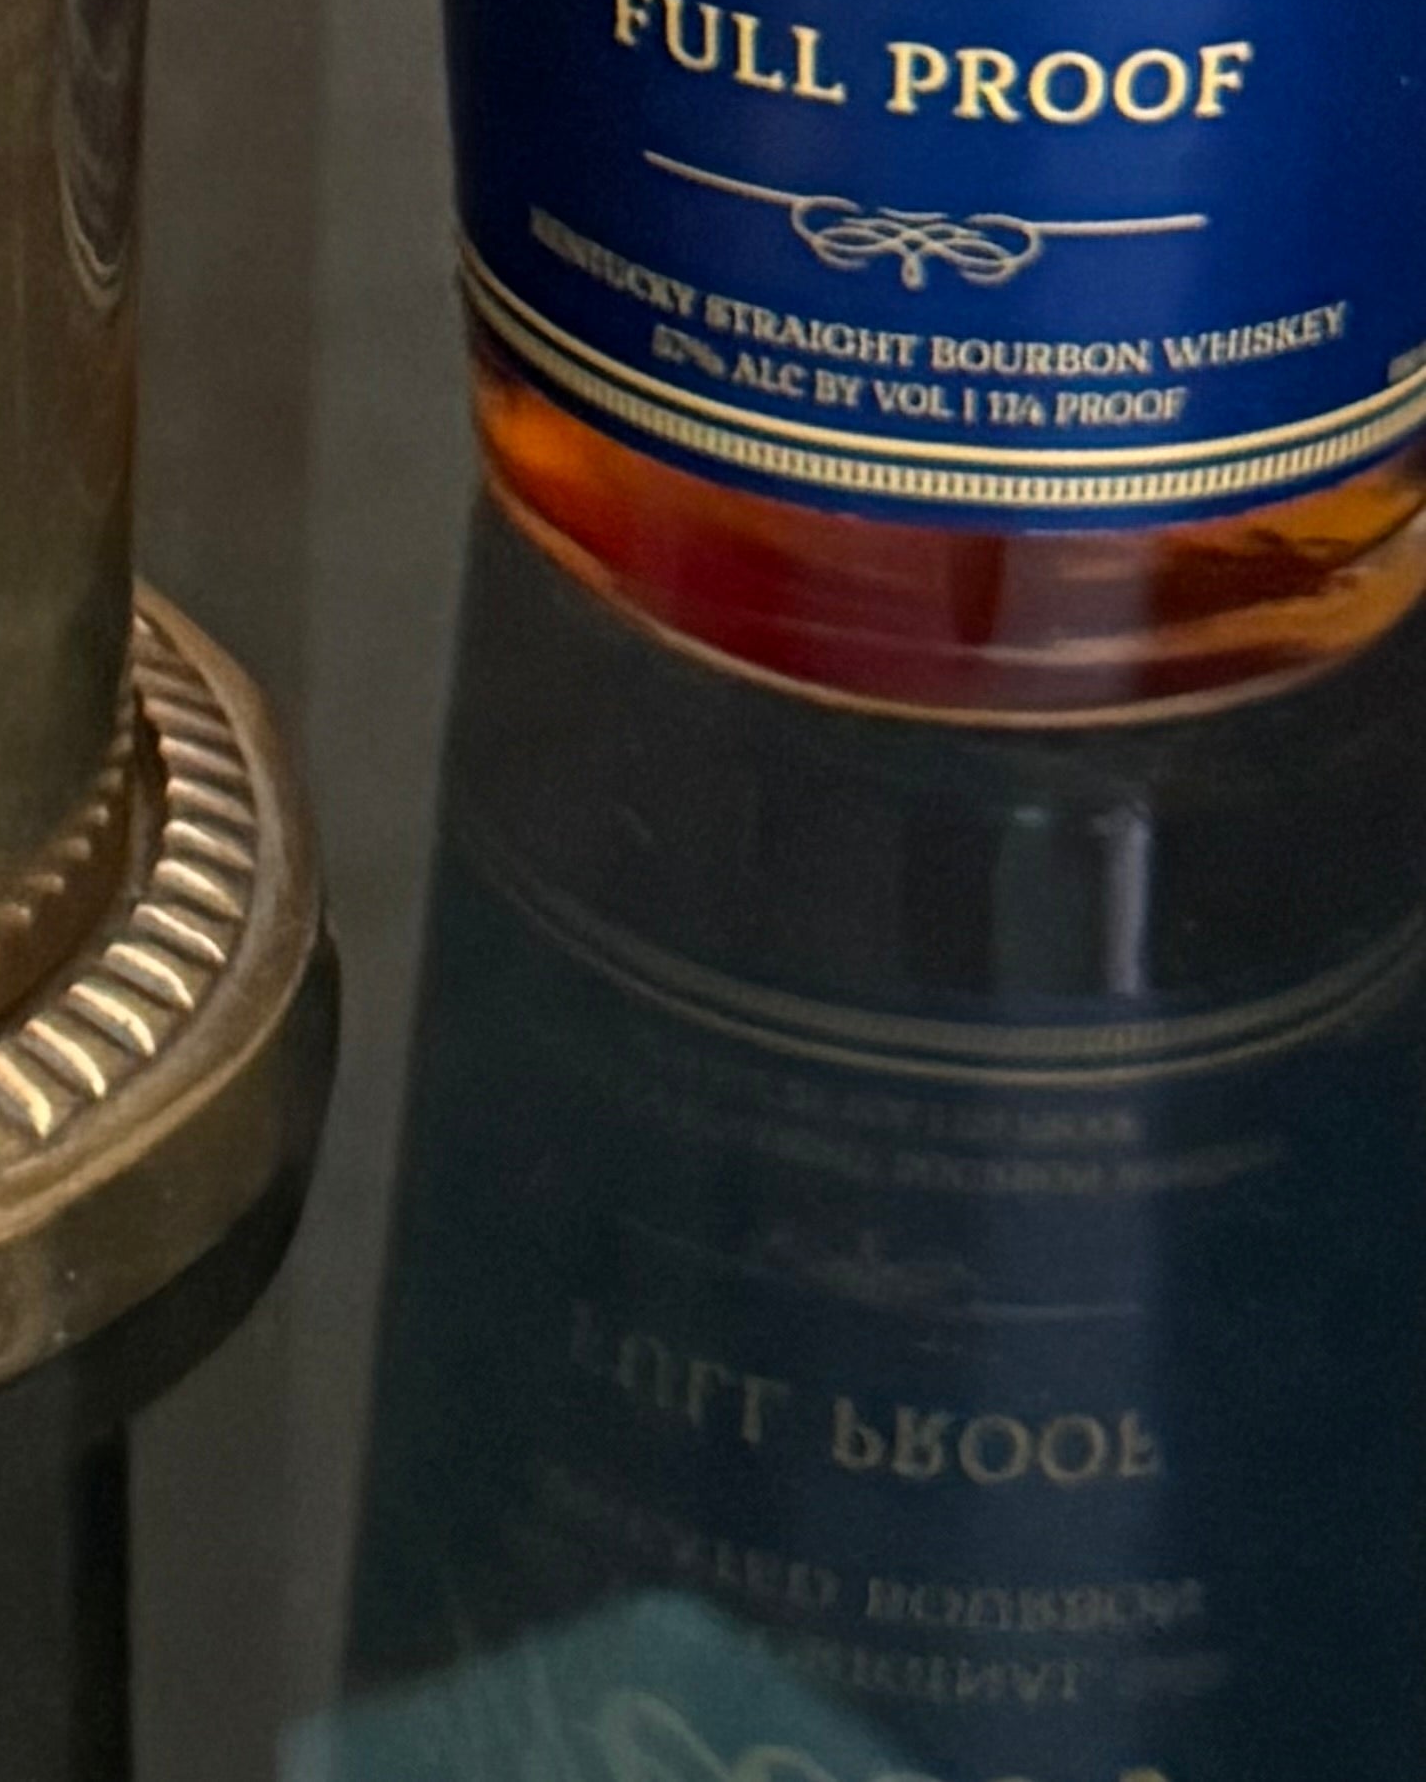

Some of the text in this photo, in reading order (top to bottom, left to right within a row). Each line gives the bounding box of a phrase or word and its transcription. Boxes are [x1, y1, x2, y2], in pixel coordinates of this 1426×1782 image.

[885, 41, 1253, 123] PROOF
[705, 293, 918, 368] STRAIGHT
[931, 336, 1151, 376] BOURBON
[1161, 299, 1347, 370] WHISKEY
[731, 352, 808, 398] ALC
[814, 368, 864, 407] BY
[873, 378, 955, 420] VOL
[988, 390, 1044, 424] 114
[1054, 386, 1188, 426] PROOF
